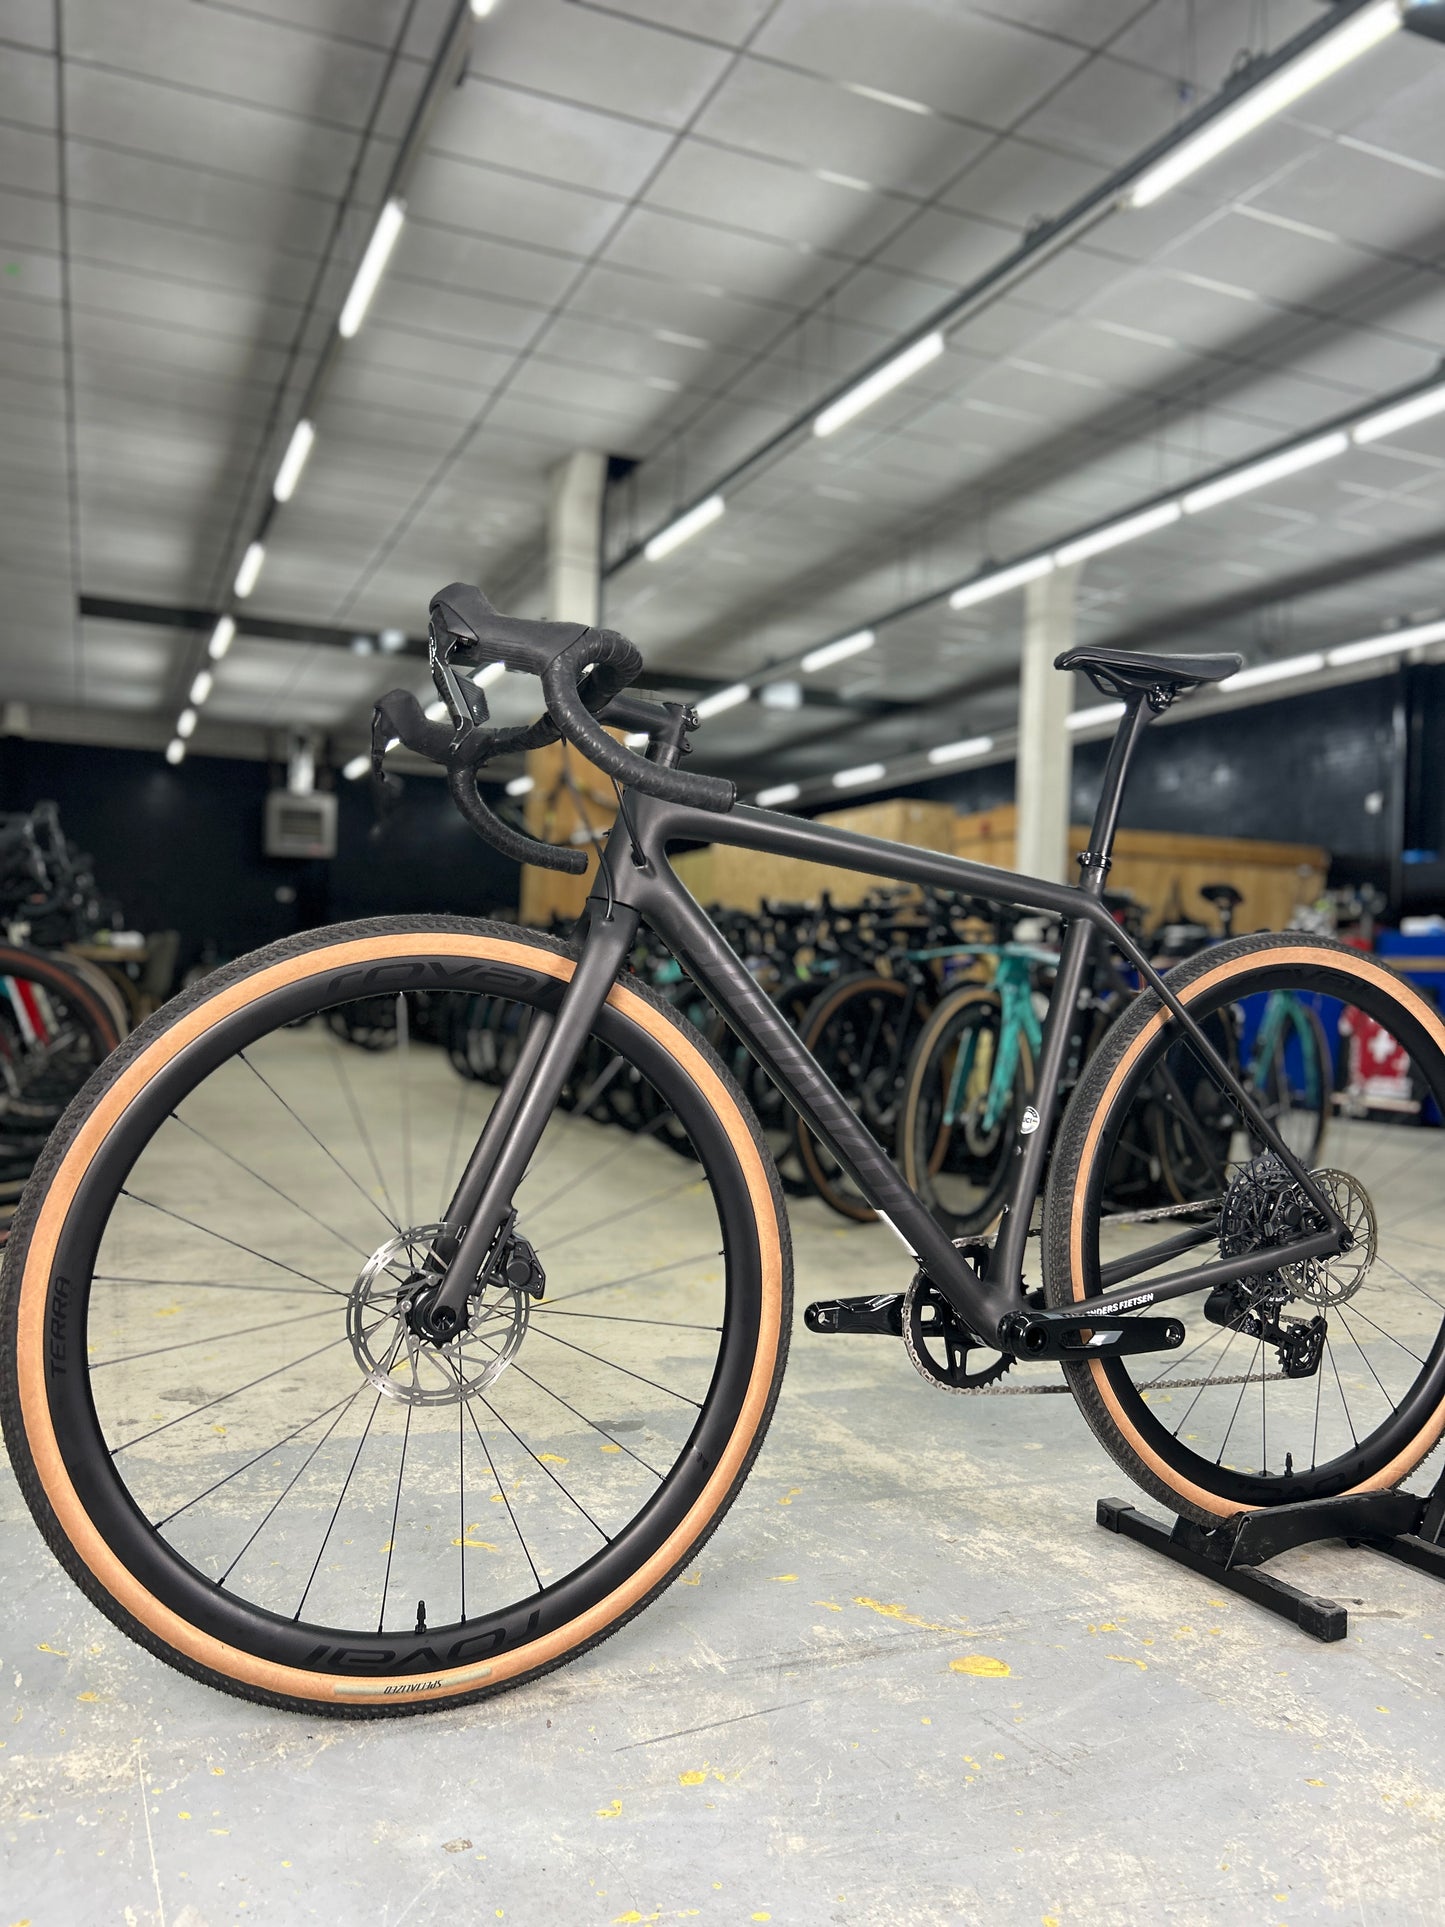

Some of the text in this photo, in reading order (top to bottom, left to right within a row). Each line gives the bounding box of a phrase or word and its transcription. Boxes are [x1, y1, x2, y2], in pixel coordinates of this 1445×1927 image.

[693, 936, 918, 1210] SPECIALIZED
[50, 1275, 71, 1378] TERRA
[1086, 1293, 1154, 1316] NDERS FIETSEN
[383, 1679, 443, 1695] SPECIALIZED
